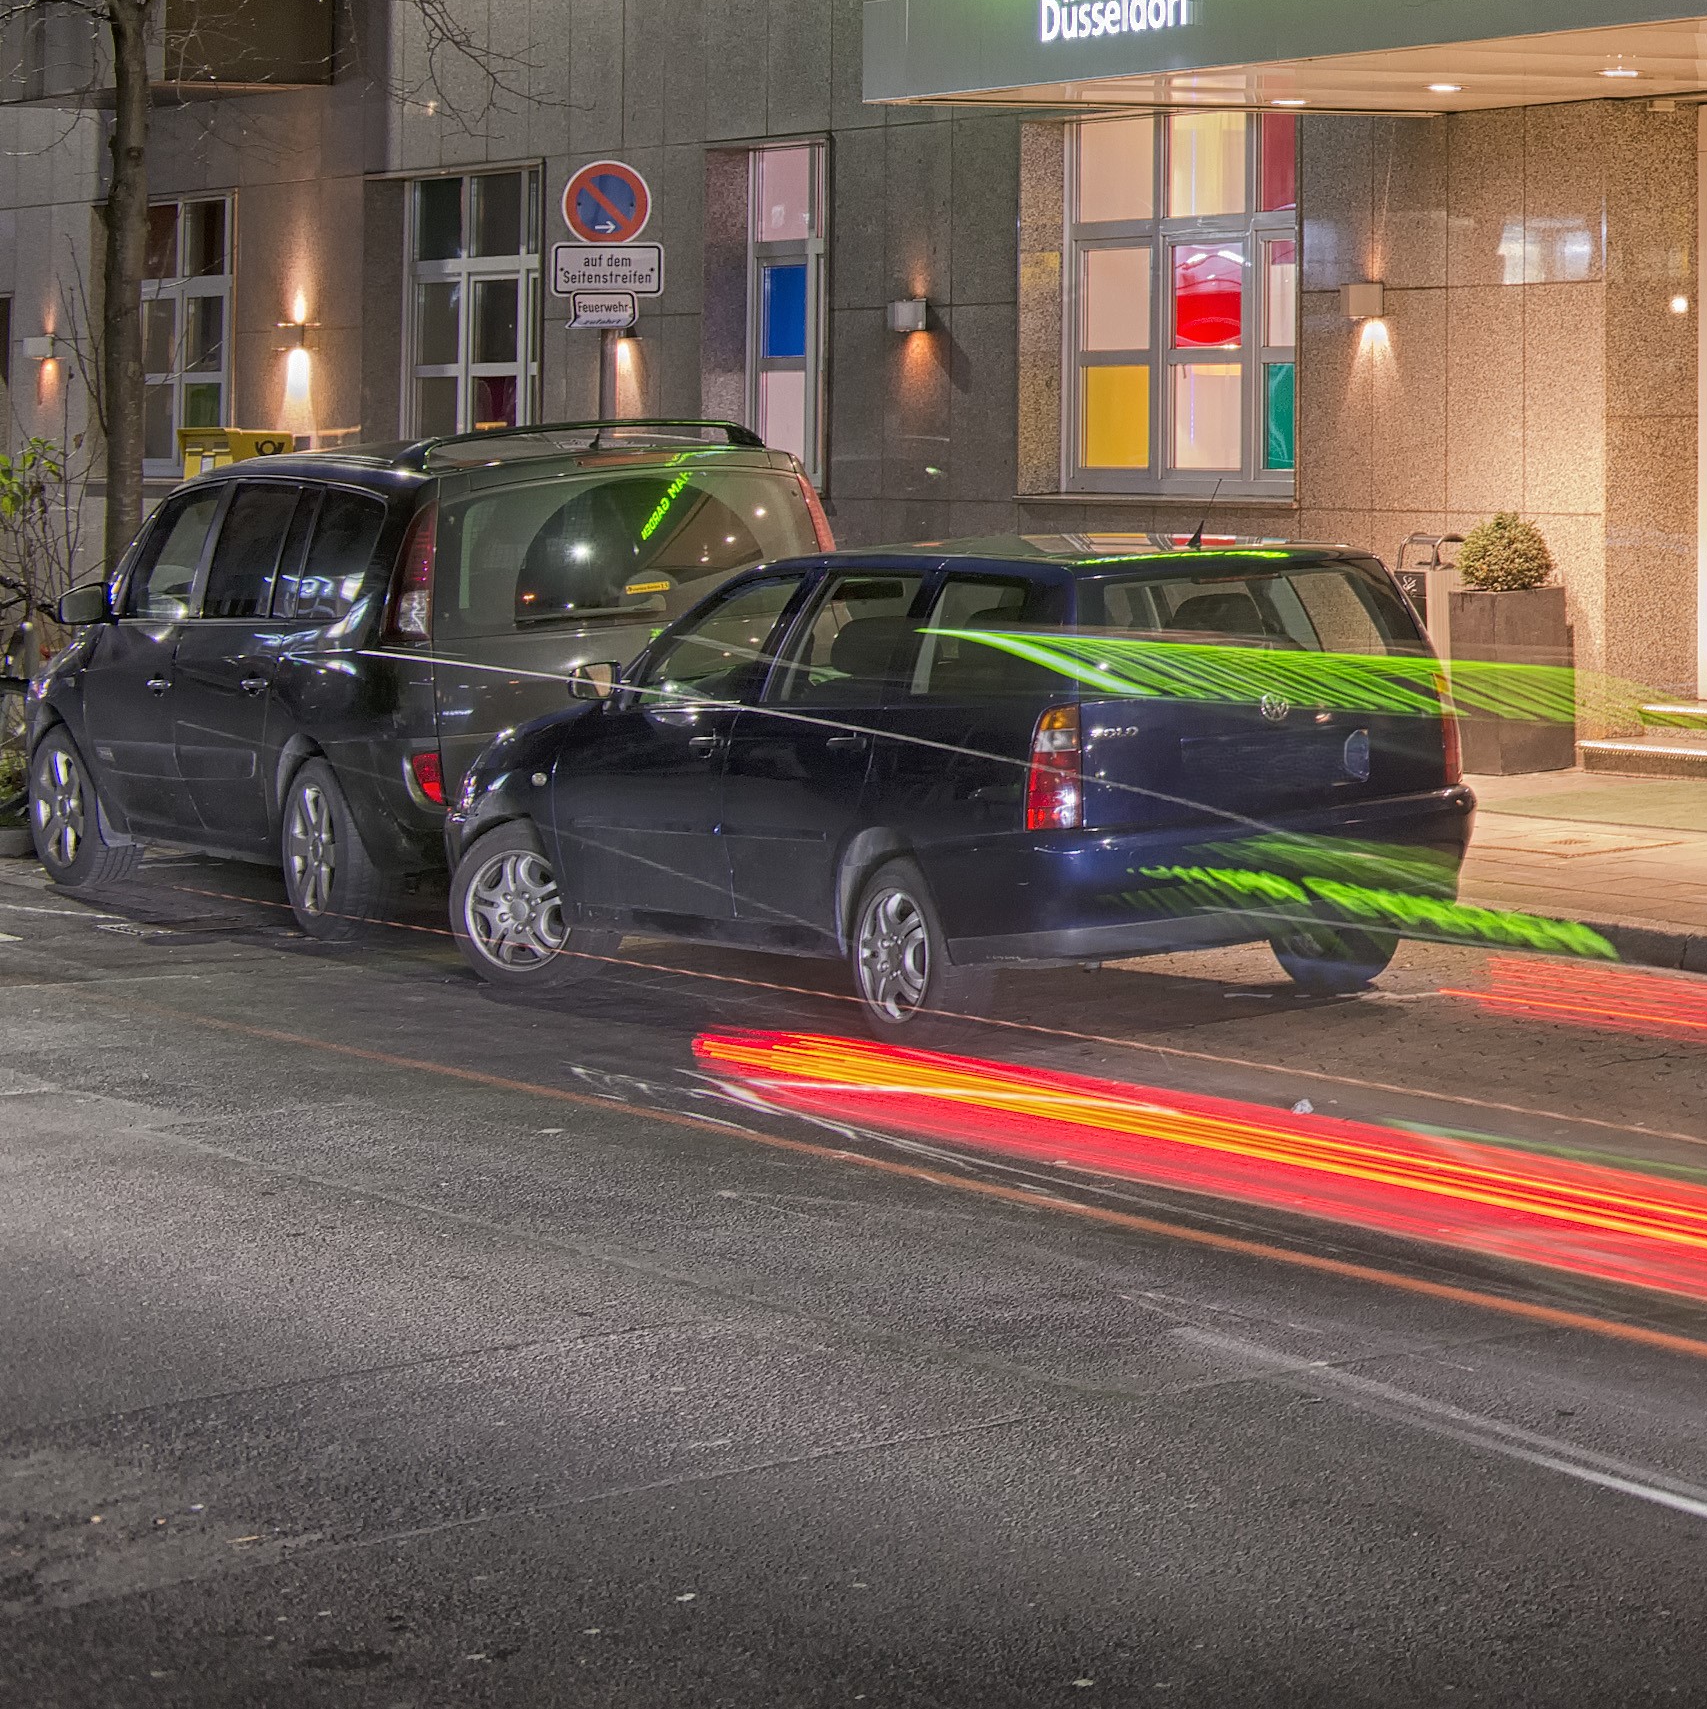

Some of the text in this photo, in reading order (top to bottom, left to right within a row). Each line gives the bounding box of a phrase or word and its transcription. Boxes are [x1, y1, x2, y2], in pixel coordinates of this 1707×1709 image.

[583, 254, 631, 267] auf dem
[563, 270, 652, 284] Seitenstreifen
[577, 301, 633, 313] Feuerwehr-
